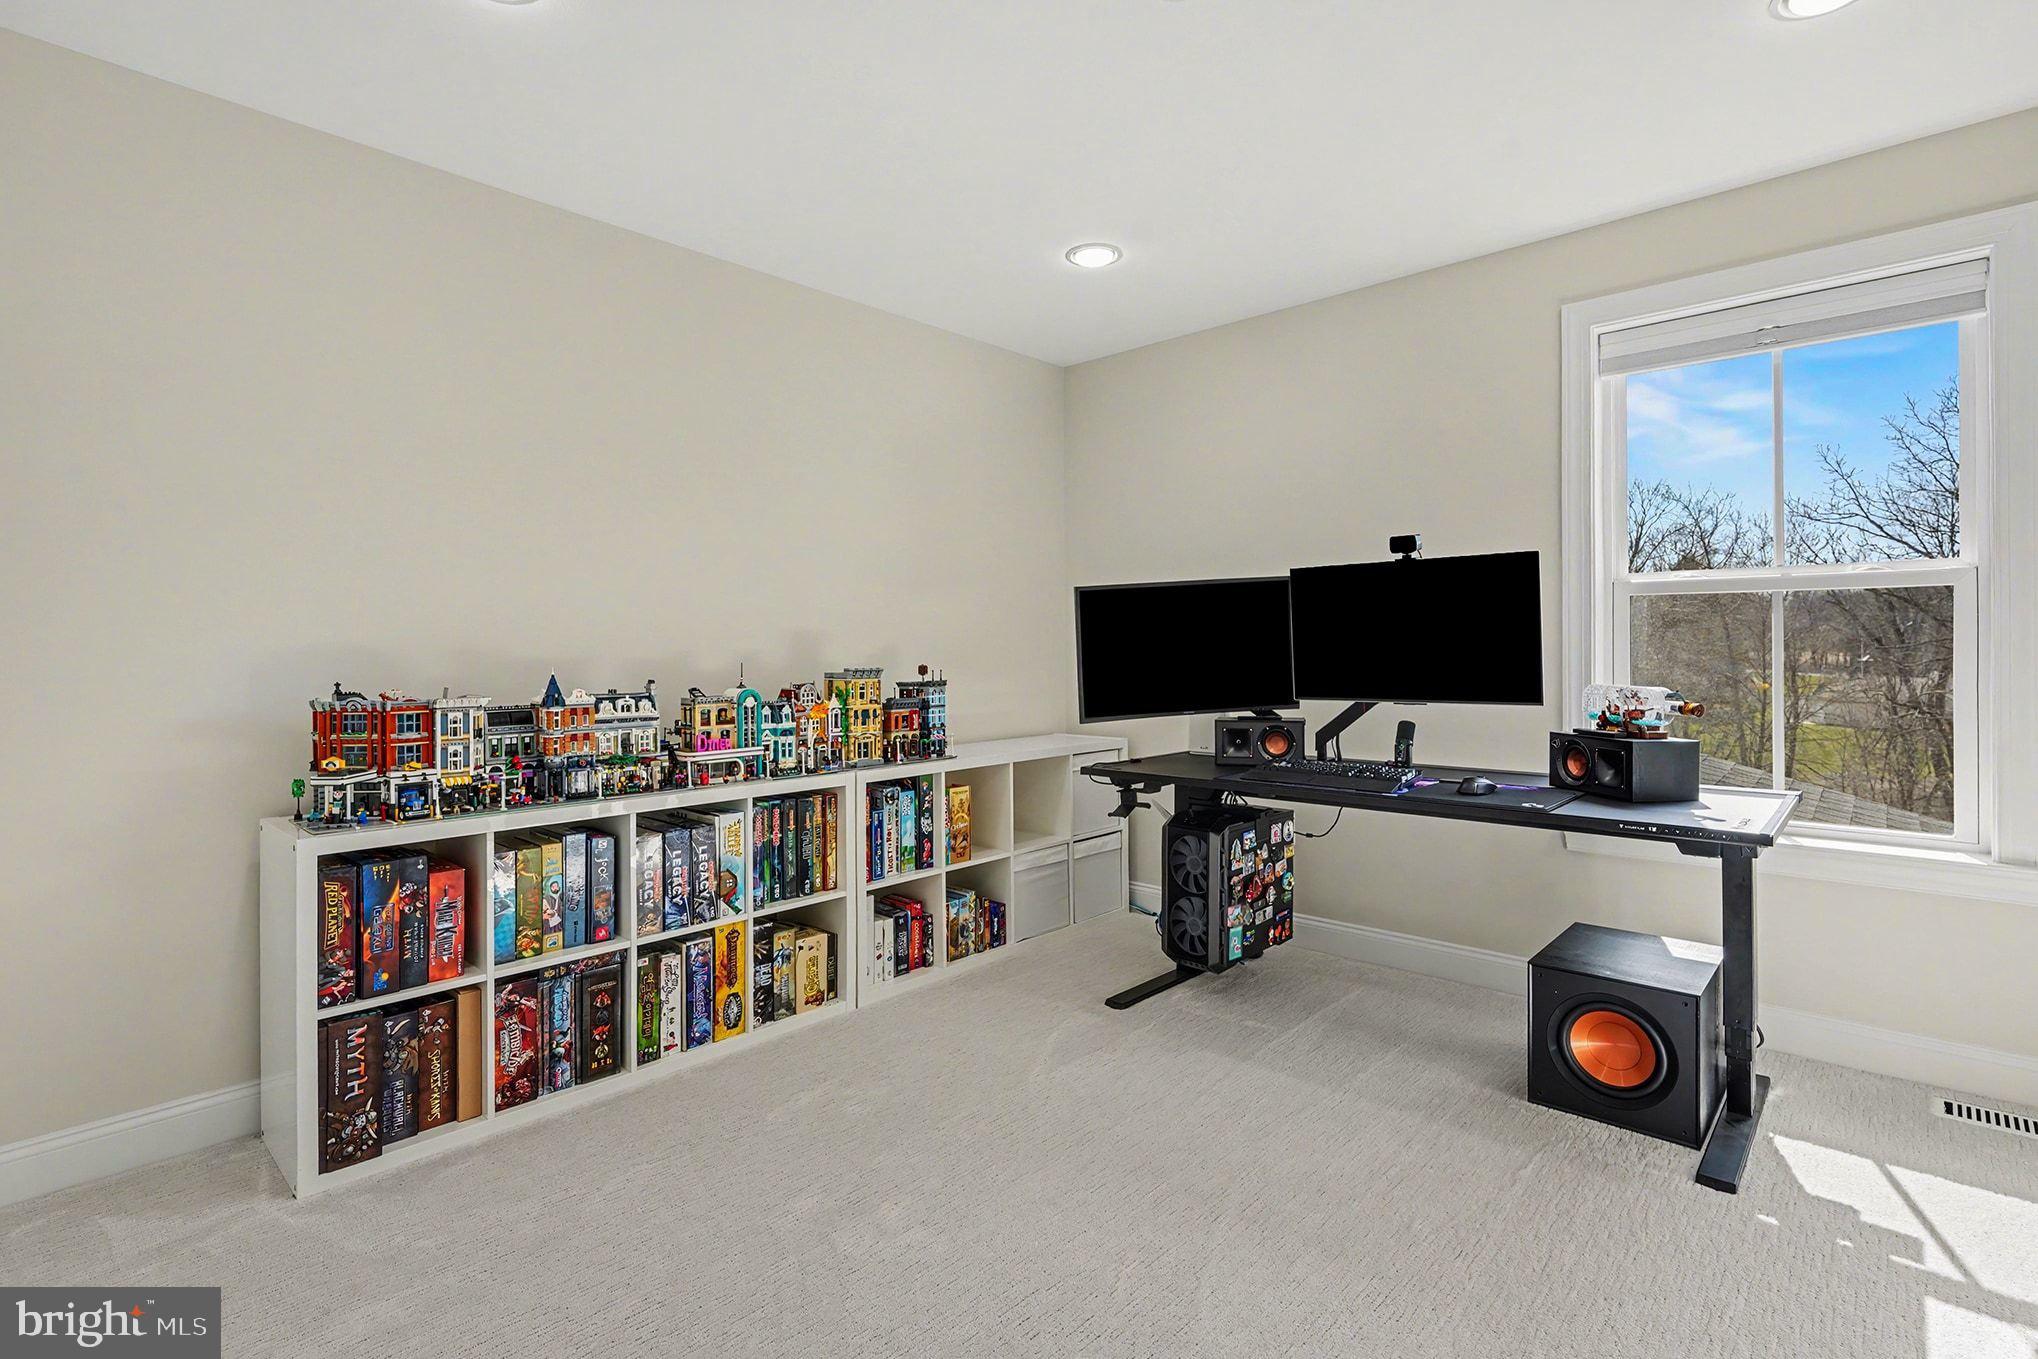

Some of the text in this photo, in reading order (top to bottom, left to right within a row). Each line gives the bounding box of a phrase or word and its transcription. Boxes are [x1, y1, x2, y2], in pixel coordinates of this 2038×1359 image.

[672, 850, 683, 905] LEGACY
[699, 845, 710, 898] LEGACY
[325, 883, 339, 946] RED PLANET
[760, 962, 772, 987] DEAD
[345, 1023, 368, 1101] MYTH
